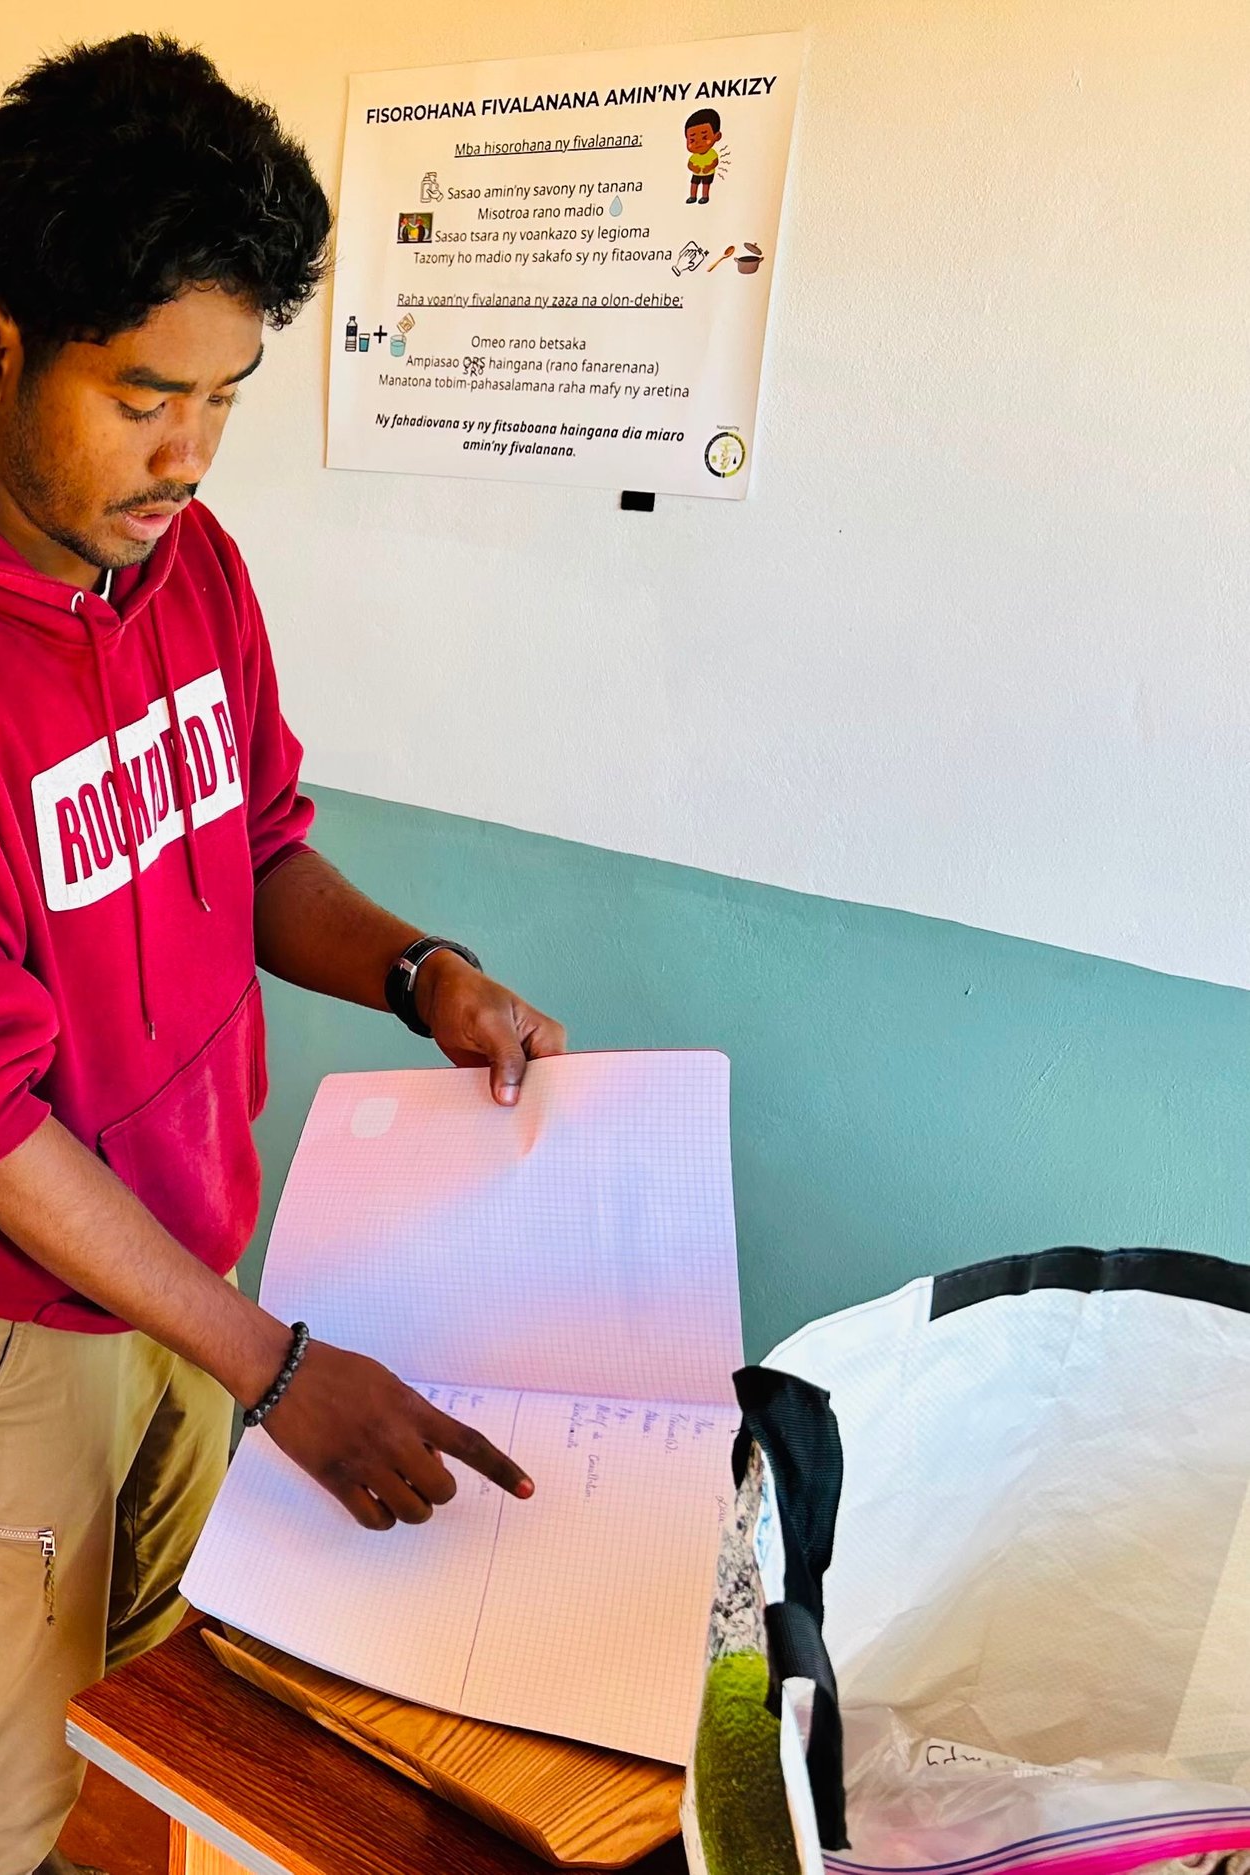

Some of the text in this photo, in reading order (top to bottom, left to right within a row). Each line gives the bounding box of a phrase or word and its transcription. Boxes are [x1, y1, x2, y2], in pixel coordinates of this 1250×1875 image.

[366, 76, 778, 124] FISOROHANA FIVALANANA AMIN'NY ANKIZY
[454, 143, 481, 156] Mba
[484, 139, 551, 154] hisorohana
[555, 138, 570, 153] ny
[447, 180, 643, 200] Sasao amin'ny savony ny tanana
[477, 203, 604, 221] Misotroa rano madio
[435, 225, 650, 245] Sasao tsara ny voankazo sy legioma
[413, 247, 672, 267] Tazomy ho madio ny sakafo sy ny fitaovana
[397, 293, 424, 307] Raha
[427, 293, 469, 309] voan'ny
[471, 293, 531, 307] fivalanana
[534, 295, 549, 309] ny
[552, 295, 579, 308] zaza
[581, 295, 597, 308] na
[471, 335, 587, 351] Omeo rano betsaka
[406, 355, 459, 370] Ampiasao
[488, 357, 543, 374] haingana
[545, 358, 578, 374] (rano
[581, 359, 660, 377] fanarenana)
[378, 374, 690, 399] Manatona tobim-pahasalamana raha mafy ny aretina
[375, 413, 685, 443] Ny fahadiovana sy ny fitsaboana haingana dia miaro
[462, 438, 576, 457] amin'ny fivalanana.
